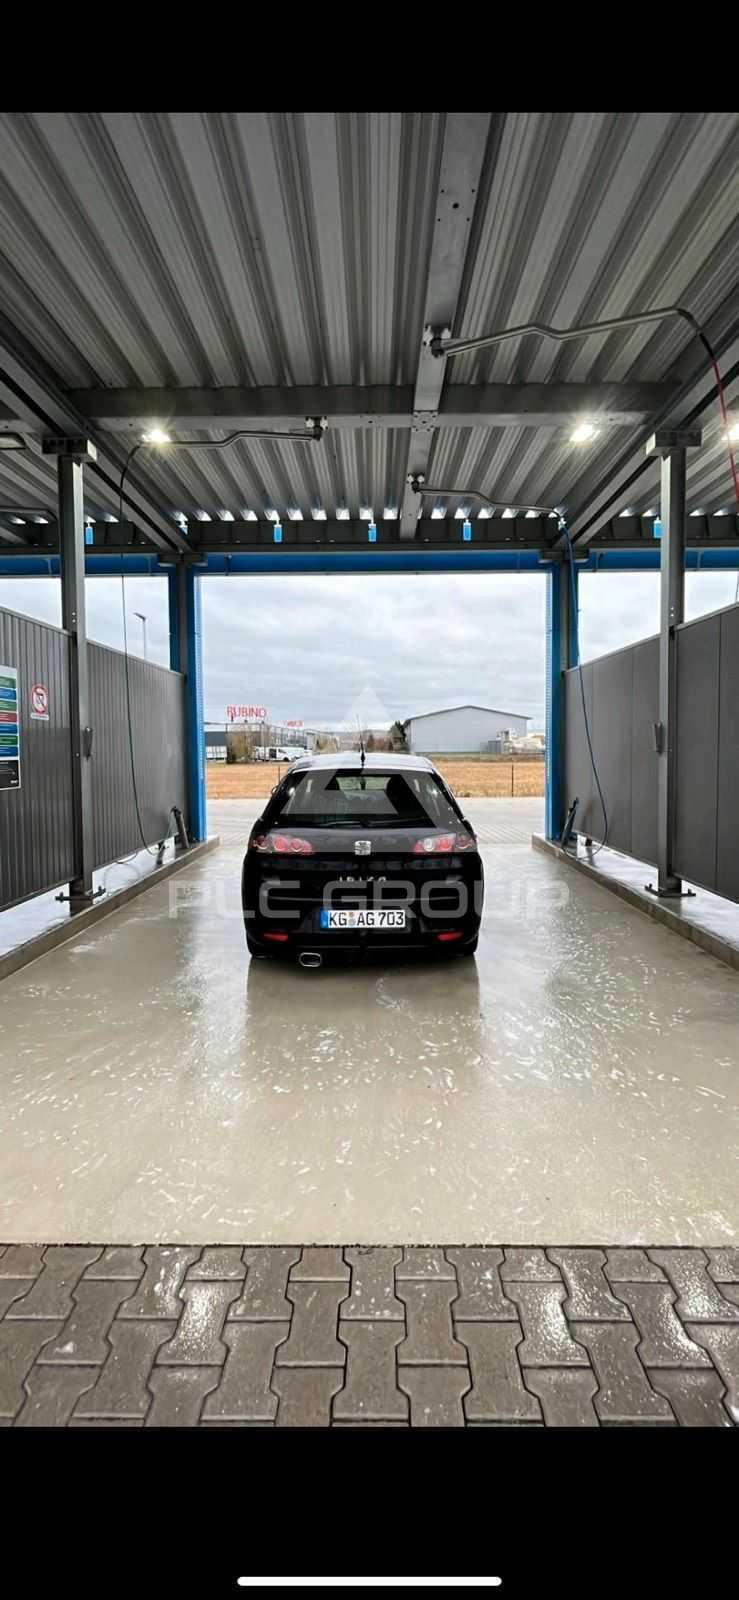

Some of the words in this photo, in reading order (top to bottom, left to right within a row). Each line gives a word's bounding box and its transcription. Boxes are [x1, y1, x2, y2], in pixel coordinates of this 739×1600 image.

[226, 705, 267, 718] RUBINO
[329, 912, 347, 926] KG
[357, 912, 375, 926] AG
[378, 912, 404, 926] 703
